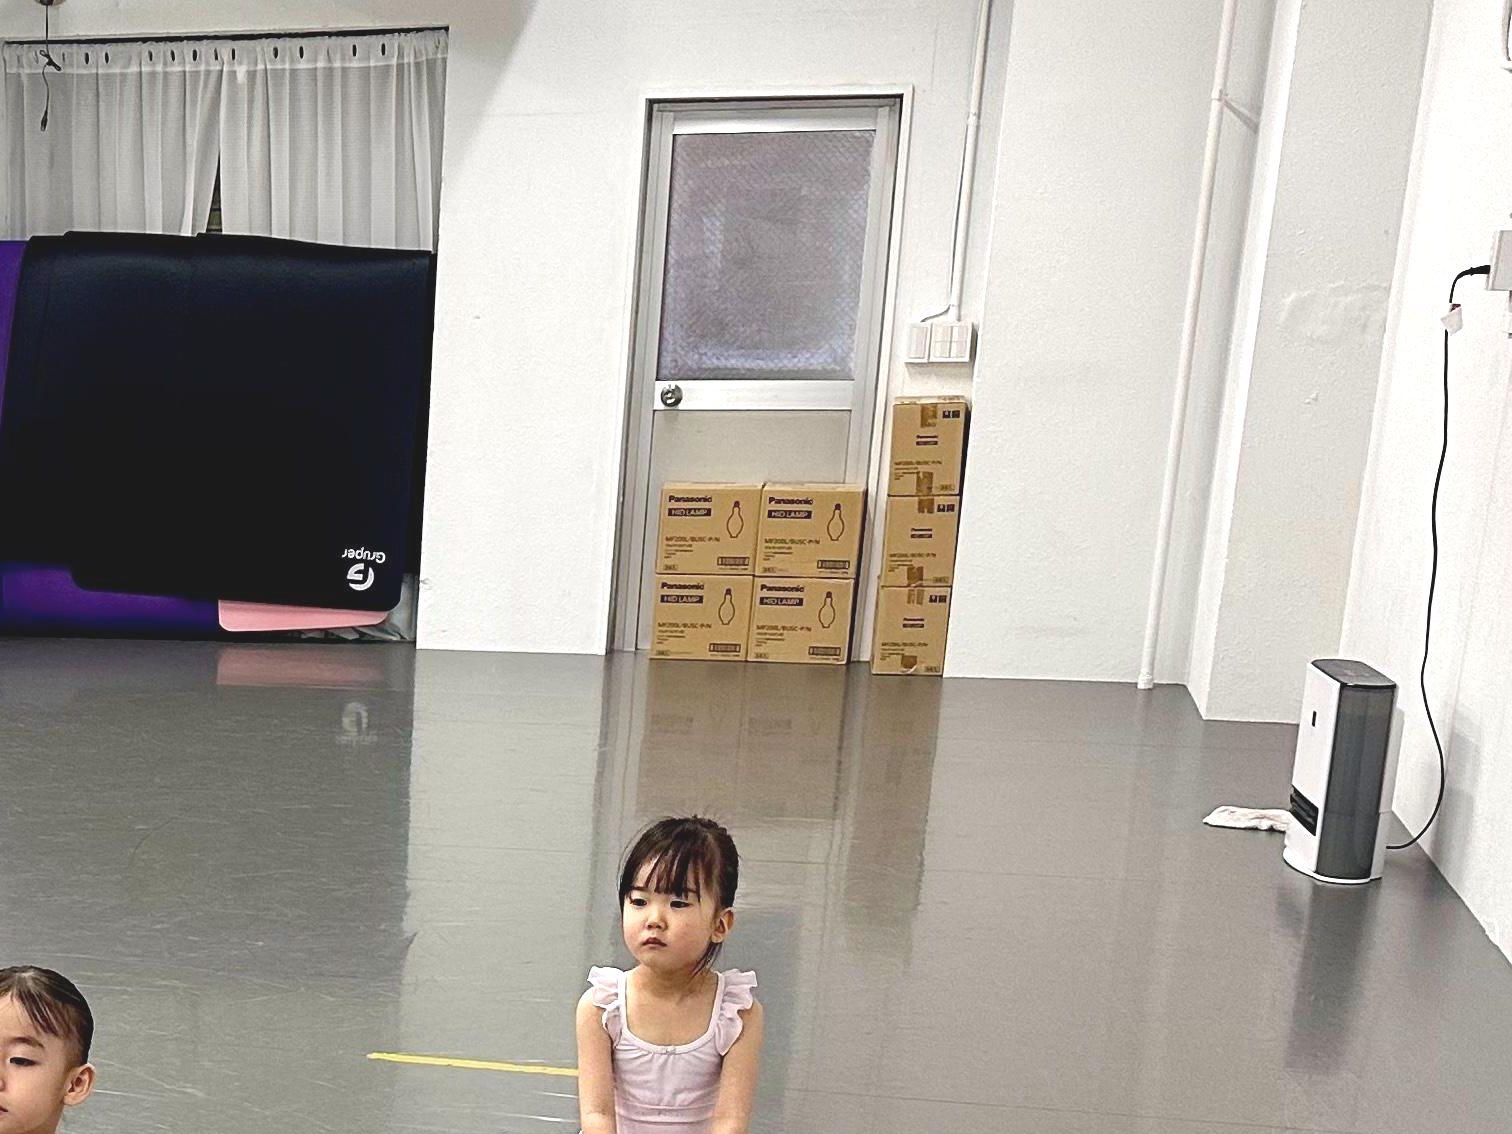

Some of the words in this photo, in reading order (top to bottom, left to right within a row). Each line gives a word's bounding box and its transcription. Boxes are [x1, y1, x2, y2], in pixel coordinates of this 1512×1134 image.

[668, 495, 713, 503] Panasonic
[768, 496, 814, 505] Panasonic
[341, 546, 386, 564] Gruper
[661, 582, 705, 590] Panasonic
[760, 584, 805, 592] Panasonic
